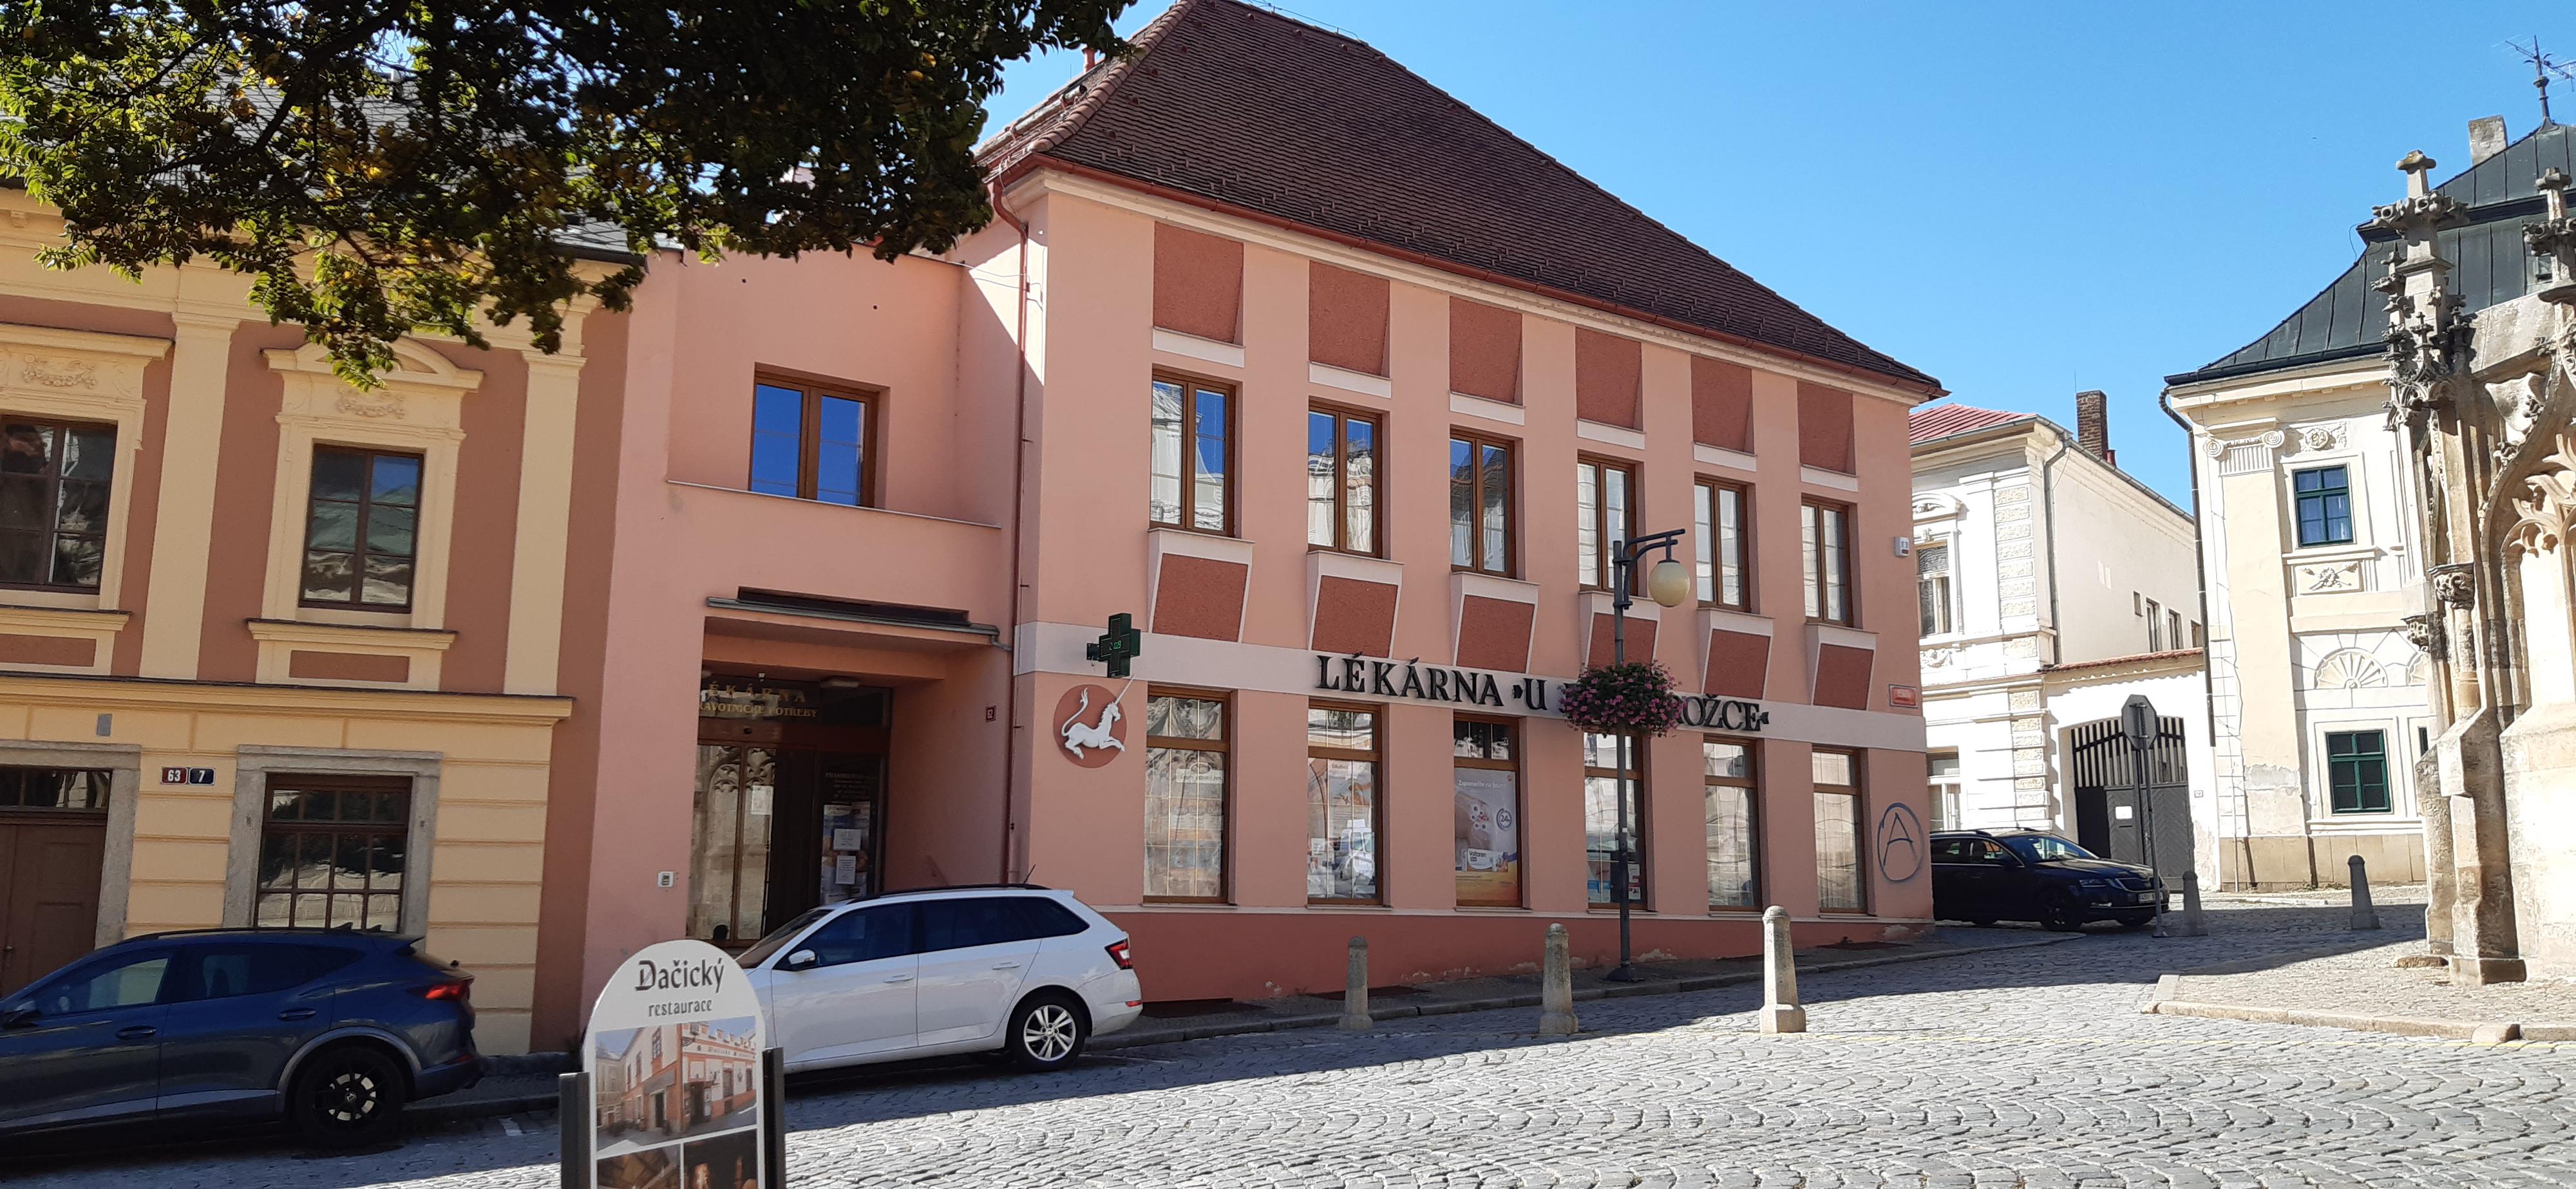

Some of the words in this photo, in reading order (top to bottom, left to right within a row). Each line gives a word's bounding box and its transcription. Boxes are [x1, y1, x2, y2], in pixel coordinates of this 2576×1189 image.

[1316, 651, 1504, 707] LÉKÁRNA
[167, 769, 181, 782] 63
[198, 770, 205, 783] 7
[634, 957, 725, 994] Dačický
[648, 999, 713, 1017] restaurace
